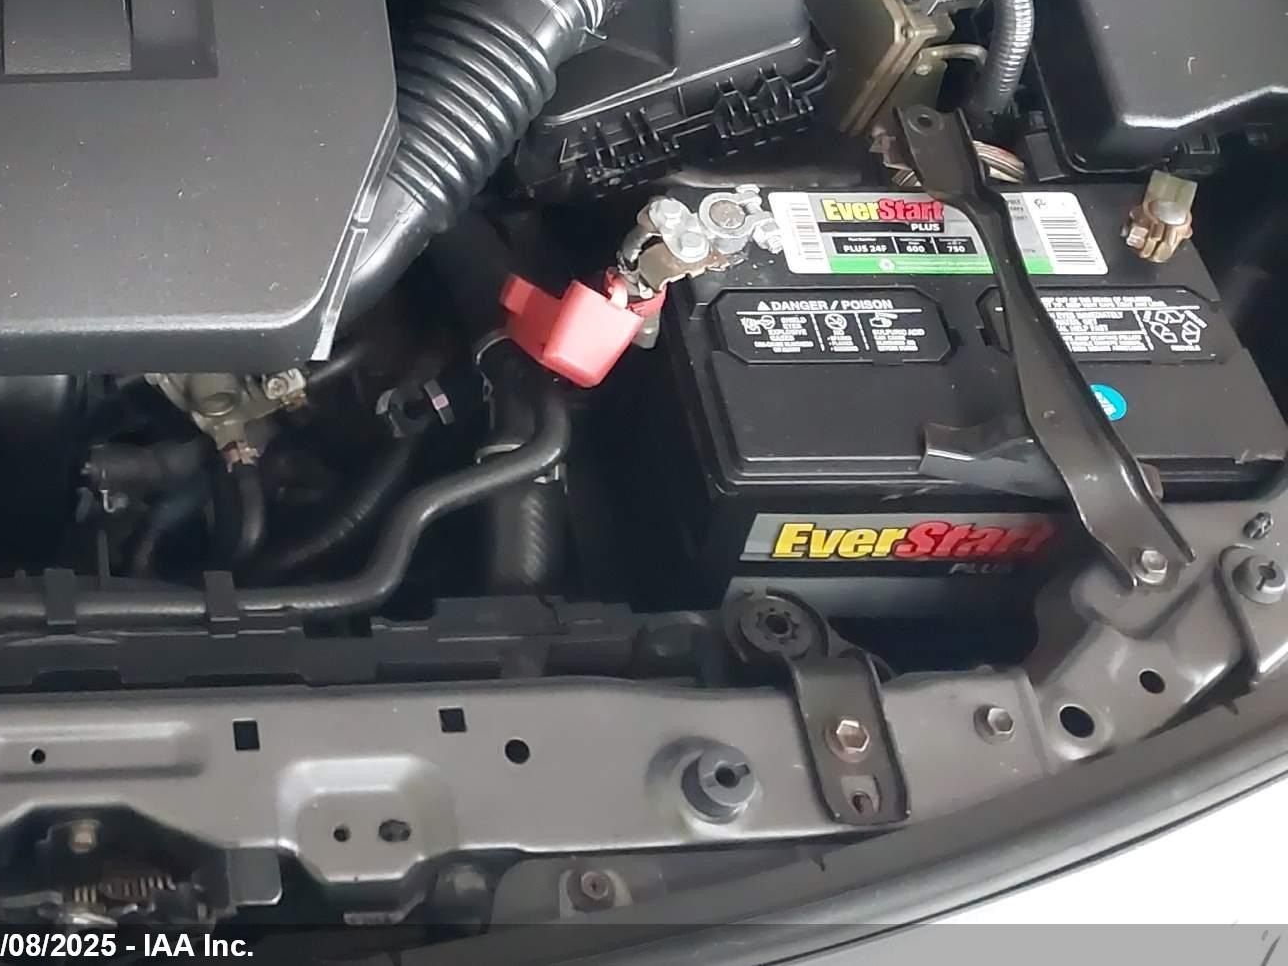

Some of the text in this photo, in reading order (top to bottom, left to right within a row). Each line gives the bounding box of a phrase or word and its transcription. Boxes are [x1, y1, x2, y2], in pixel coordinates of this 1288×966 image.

[821, 198, 944, 222] EverStart
[911, 223, 941, 232] PLUS
[843, 244, 869, 253] PLUS
[906, 244, 926, 253] 600
[946, 244, 966, 253] 750
[771, 300, 829, 311] DANGER
[840, 299, 894, 310] POISON
[770, 522, 1054, 559] EverStart
